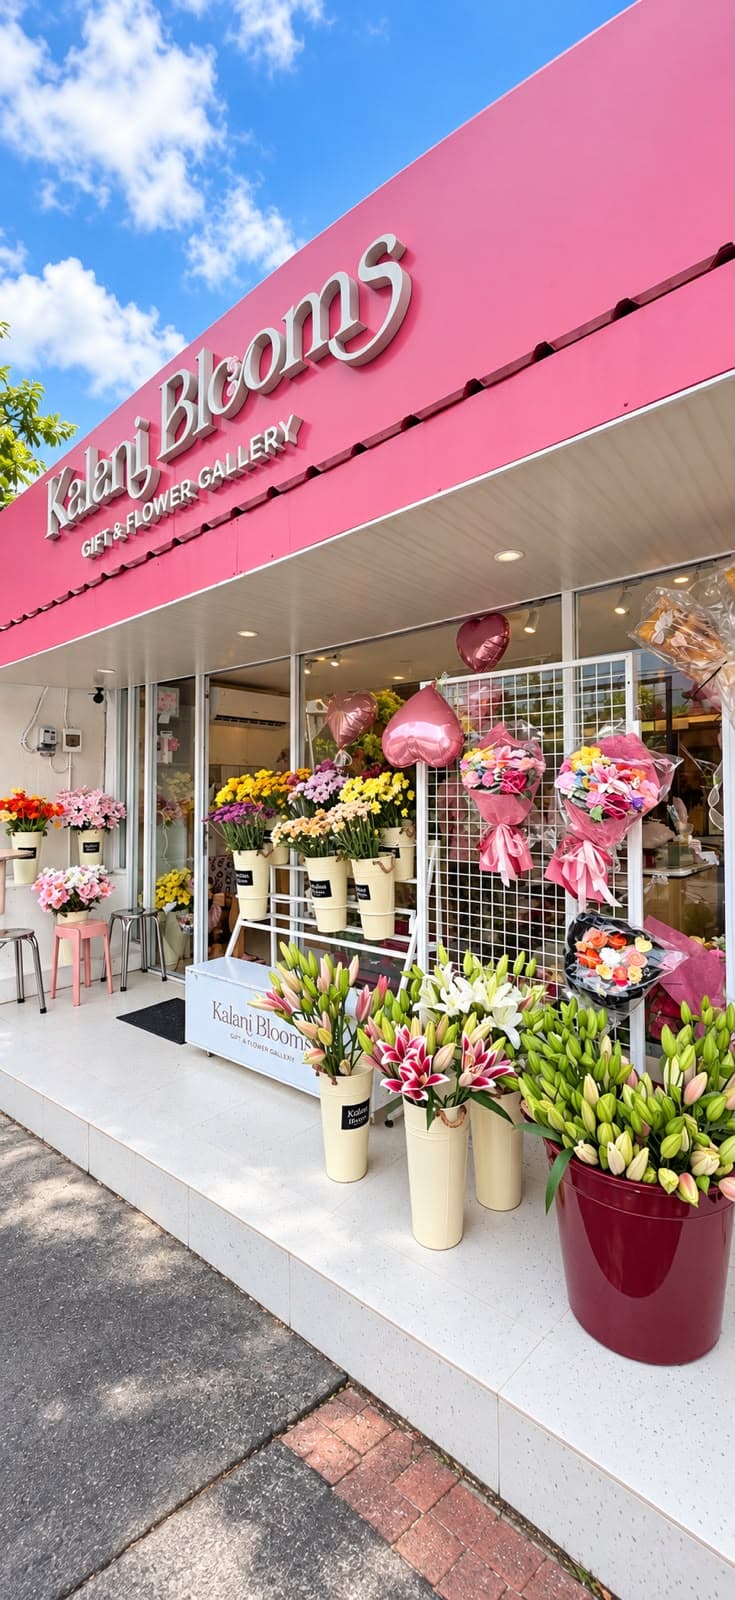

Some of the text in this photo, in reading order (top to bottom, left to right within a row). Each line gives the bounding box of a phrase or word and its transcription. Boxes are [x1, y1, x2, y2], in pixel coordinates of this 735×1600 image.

[45, 233, 412, 540] Kalani Blooms
[81, 414, 304, 560] GIFT & FLOWER GALLERY
[212, 1000, 254, 1037] Kalani
[247, 1039, 269, 1053] FLOWER
